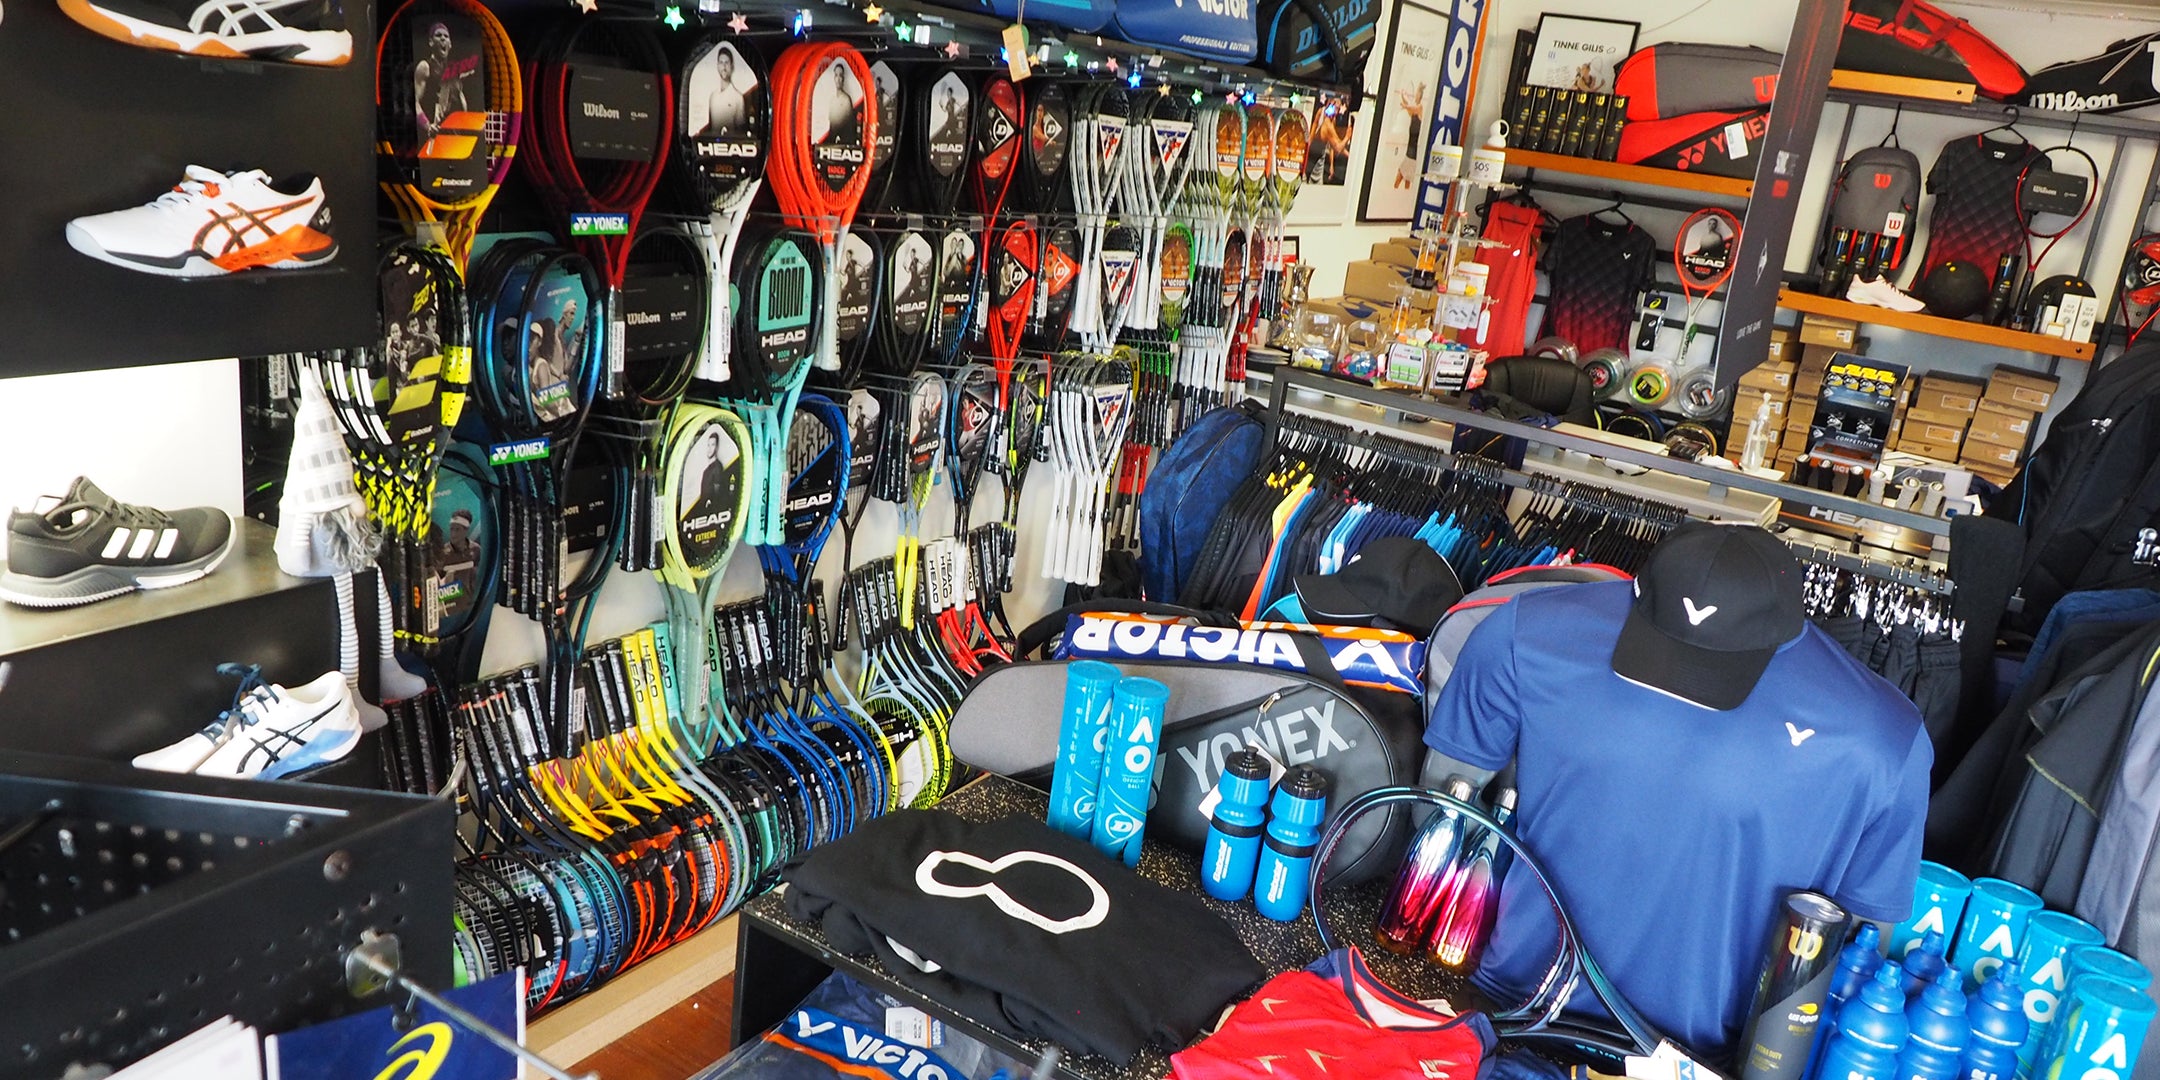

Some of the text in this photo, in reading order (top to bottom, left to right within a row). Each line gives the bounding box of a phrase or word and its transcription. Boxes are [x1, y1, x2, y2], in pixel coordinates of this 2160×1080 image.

[1179, 35, 1250, 52] PROFESSIONALS EDITION
[1553, 40, 1604, 53] TINNE GILIS
[2029, 90, 2119, 112] Wilson
[583, 102, 620, 119] Wilson
[698, 142, 758, 157] HEAD
[876, 135, 894, 146] AD
[931, 143, 964, 154] HEAD
[819, 147, 864, 162] HEAD
[1474, 161, 1490, 172] SOS
[593, 216, 625, 232] YONEX
[1685, 256, 1726, 268] HEAD
[840, 305, 869, 317] EAD
[895, 300, 927, 314] HEAD
[626, 311, 661, 325] Wilson
[761, 329, 807, 348] HEAD
[512, 441, 546, 459] YONEX
[913, 440, 940, 455] HEAD
[1835, 435, 1879, 449] COMPETITION
[850, 454, 874, 466] EAD
[784, 493, 833, 512] HEAD
[683, 510, 732, 533] HEAD
[929, 560, 939, 604] HEAD
[940, 556, 949, 598] HEAD
[437, 583, 460, 600] ONEX
[877, 574, 889, 620] HEAD
[887, 571, 898, 618] HEAD
[858, 587, 871, 635] HEAD
[868, 581, 880, 629] HEAD
[816, 595, 829, 645] HEAD
[730, 617, 747, 668] HEAD
[757, 610, 773, 661] HEAD
[1072, 617, 1307, 667] VICTOR
[717, 619, 732, 672] HEAD
[642, 645, 658, 698] HEAD
[656, 636, 672, 689] HEAD
[626, 650, 644, 703] HEAD
[1177, 698, 1350, 794] YONEX
[1122, 776, 1146, 784] OFFICIAL
